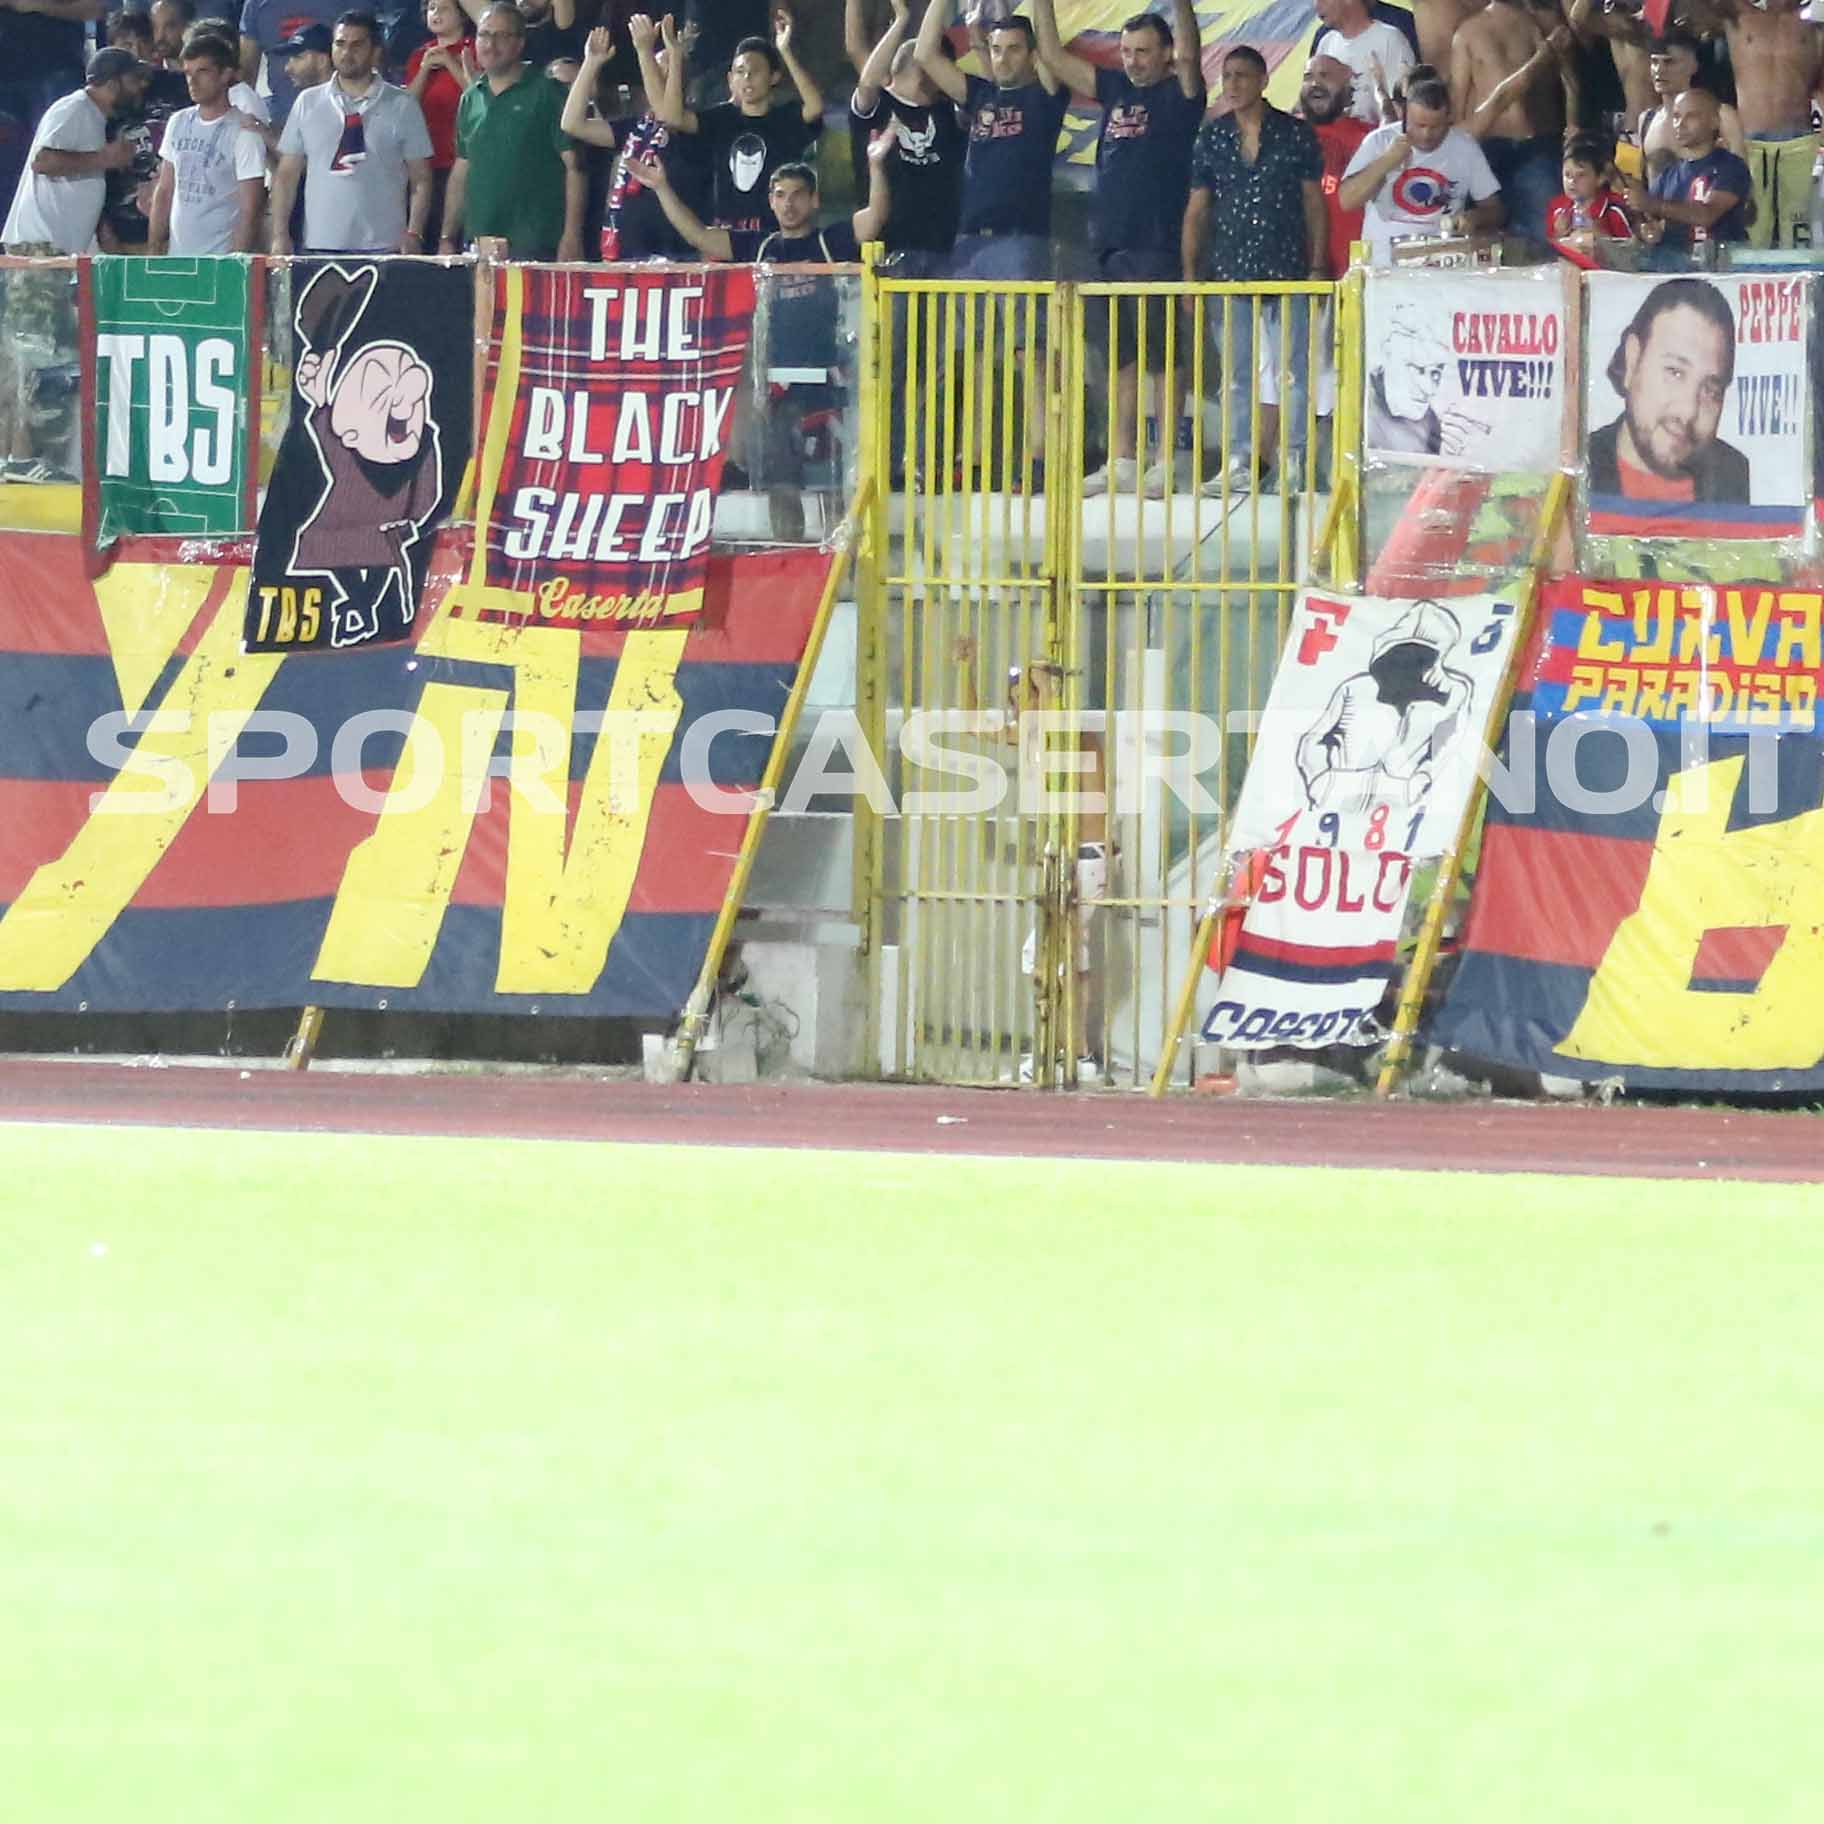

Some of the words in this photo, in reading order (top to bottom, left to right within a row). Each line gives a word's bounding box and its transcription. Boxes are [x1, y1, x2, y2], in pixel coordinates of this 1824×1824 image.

[583, 285, 704, 363] THE
[1452, 311, 1558, 355] CAVALLO
[1737, 280, 1802, 344] PEPPE
[96, 333, 235, 486] TBS
[1457, 358, 1553, 398] VIVE!!!
[1736, 374, 1798, 436] VIVE!!
[522, 386, 734, 465] BLACK
[506, 486, 713, 564] SHEEP
[256, 586, 323, 645] TBS
[540, 577, 664, 620] Caserta
[1576, 587, 1824, 669] CURVA
[1273, 805, 1426, 852] 1981
[1257, 844, 1414, 914] SOLO
